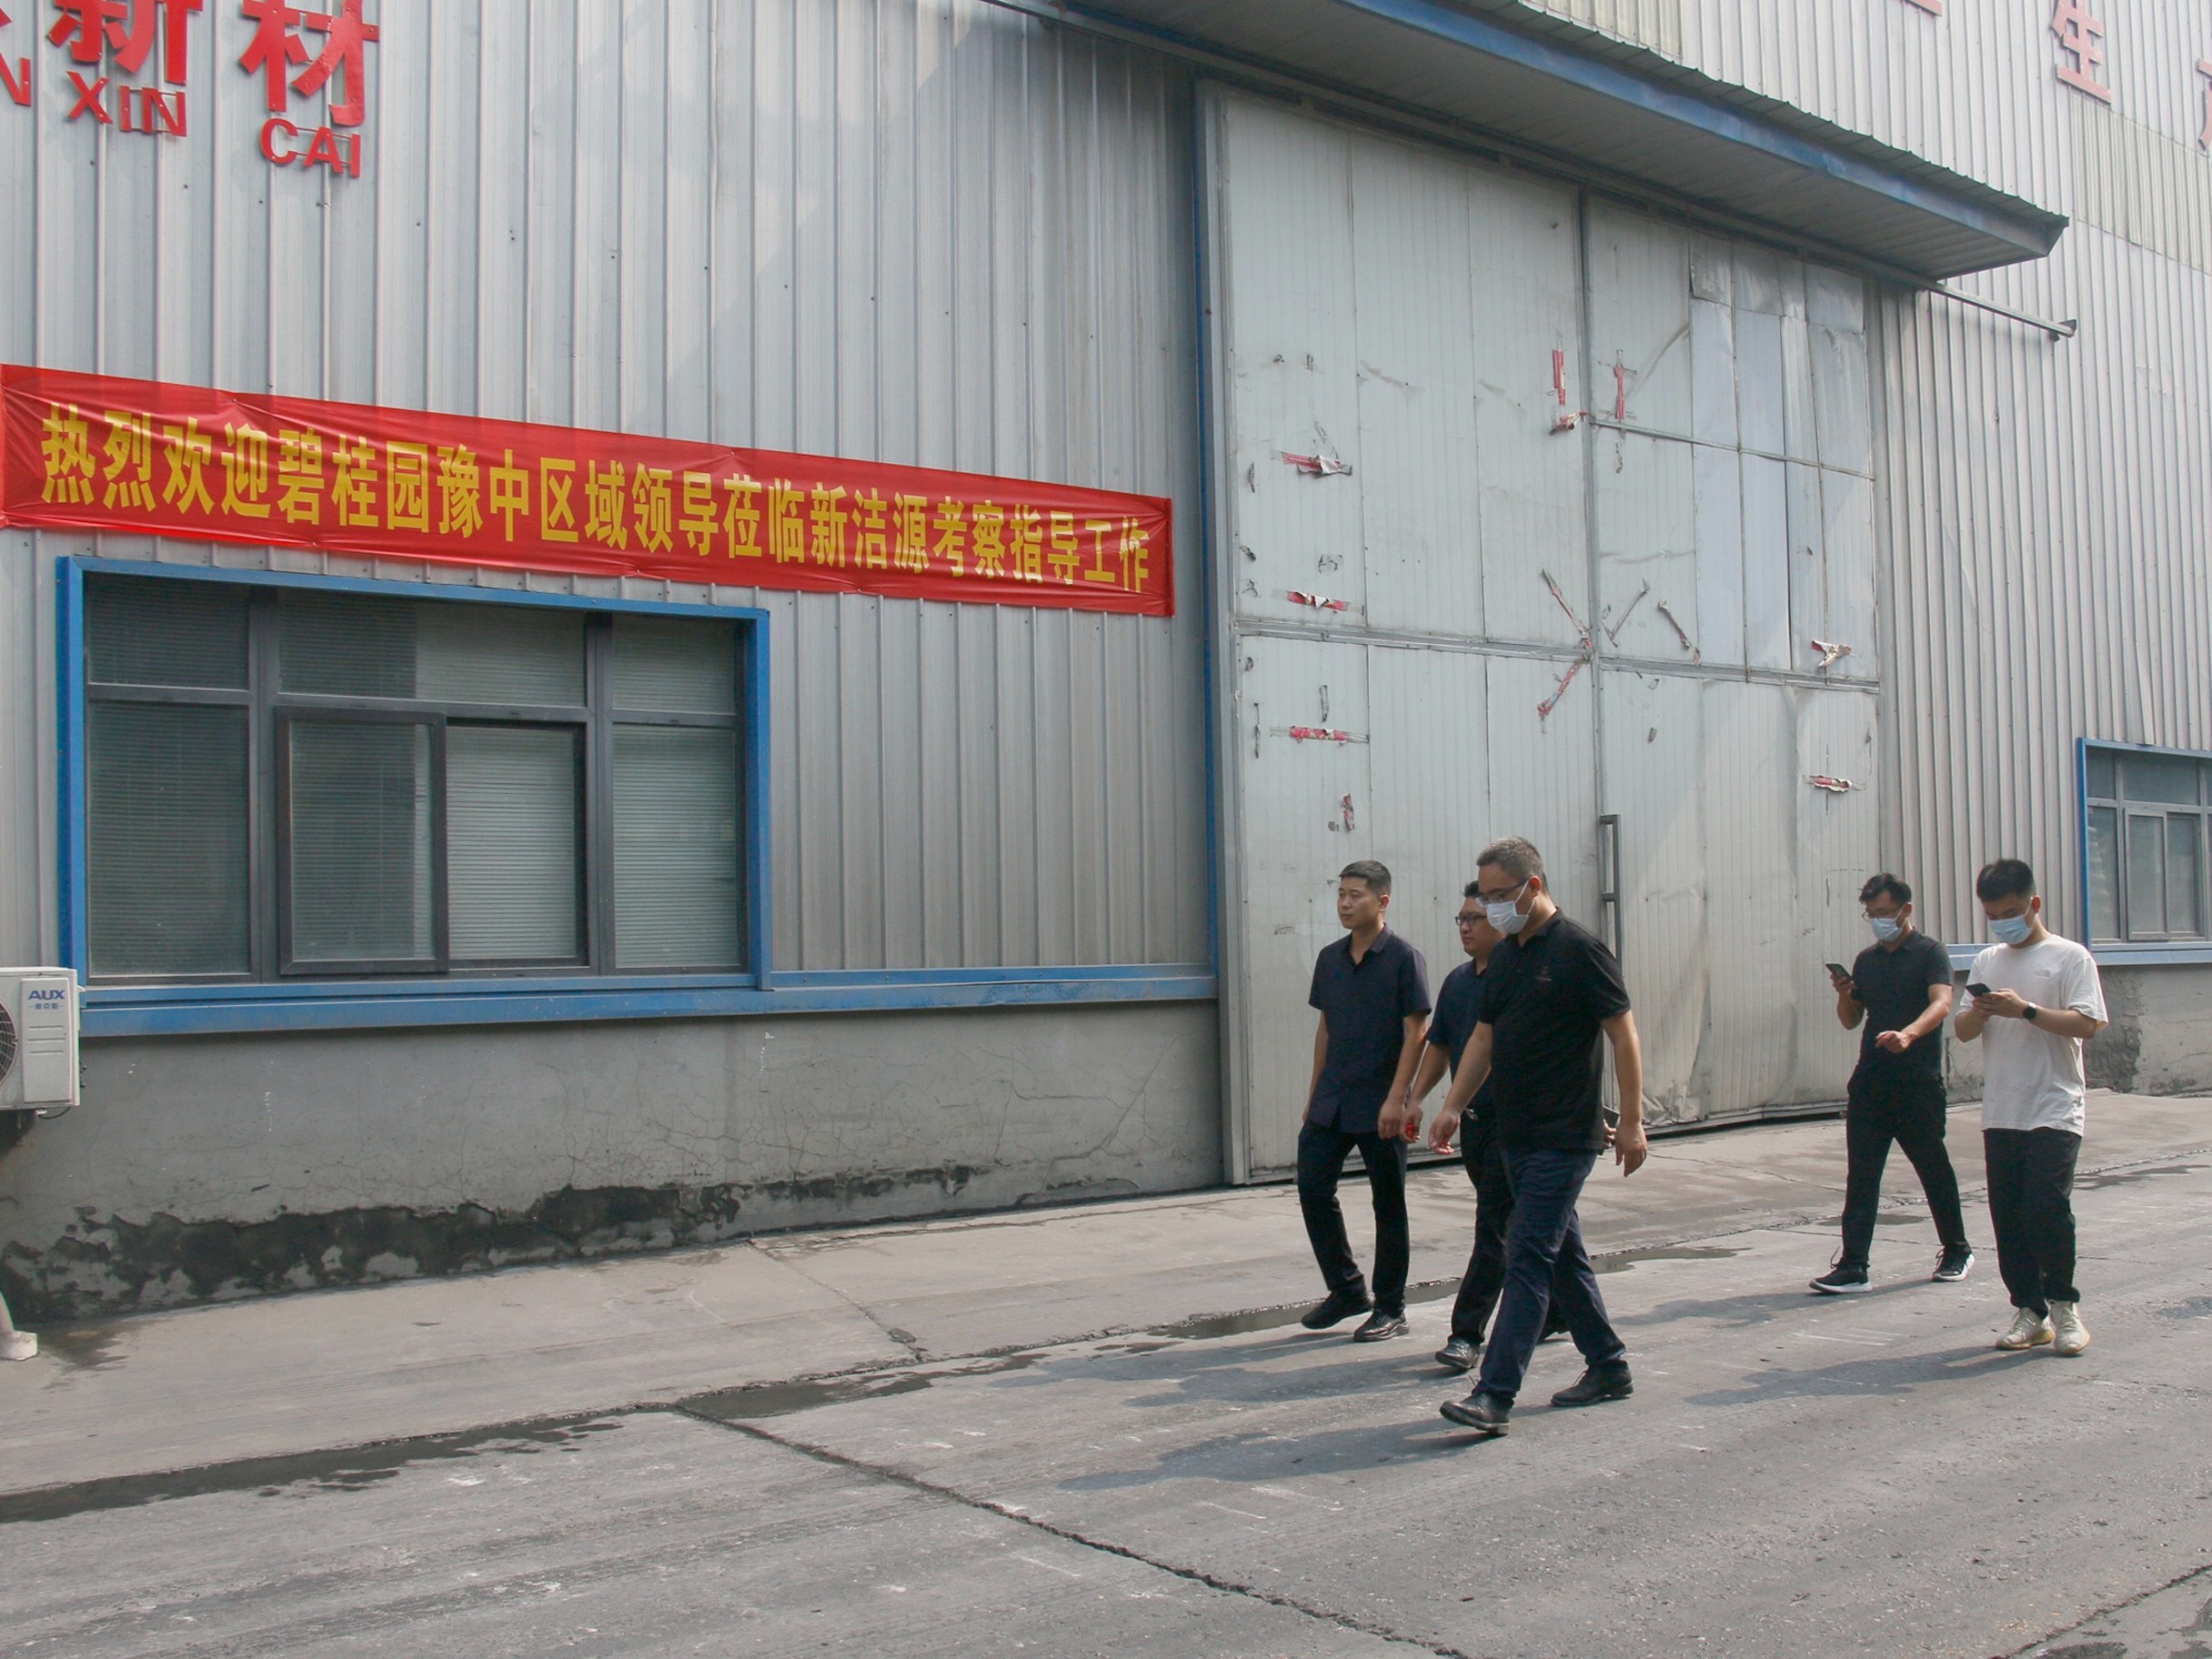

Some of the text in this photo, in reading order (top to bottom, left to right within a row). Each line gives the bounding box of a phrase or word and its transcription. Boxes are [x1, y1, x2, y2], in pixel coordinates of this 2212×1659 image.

[66, 71, 187, 137] XIN
[259, 117, 361, 178] CAI
[41, 402, 1151, 593] 热烈欢迎碧桂园豫中区域领导莅临新洁源考察指导工作
[28, 990, 65, 1000] AUX
